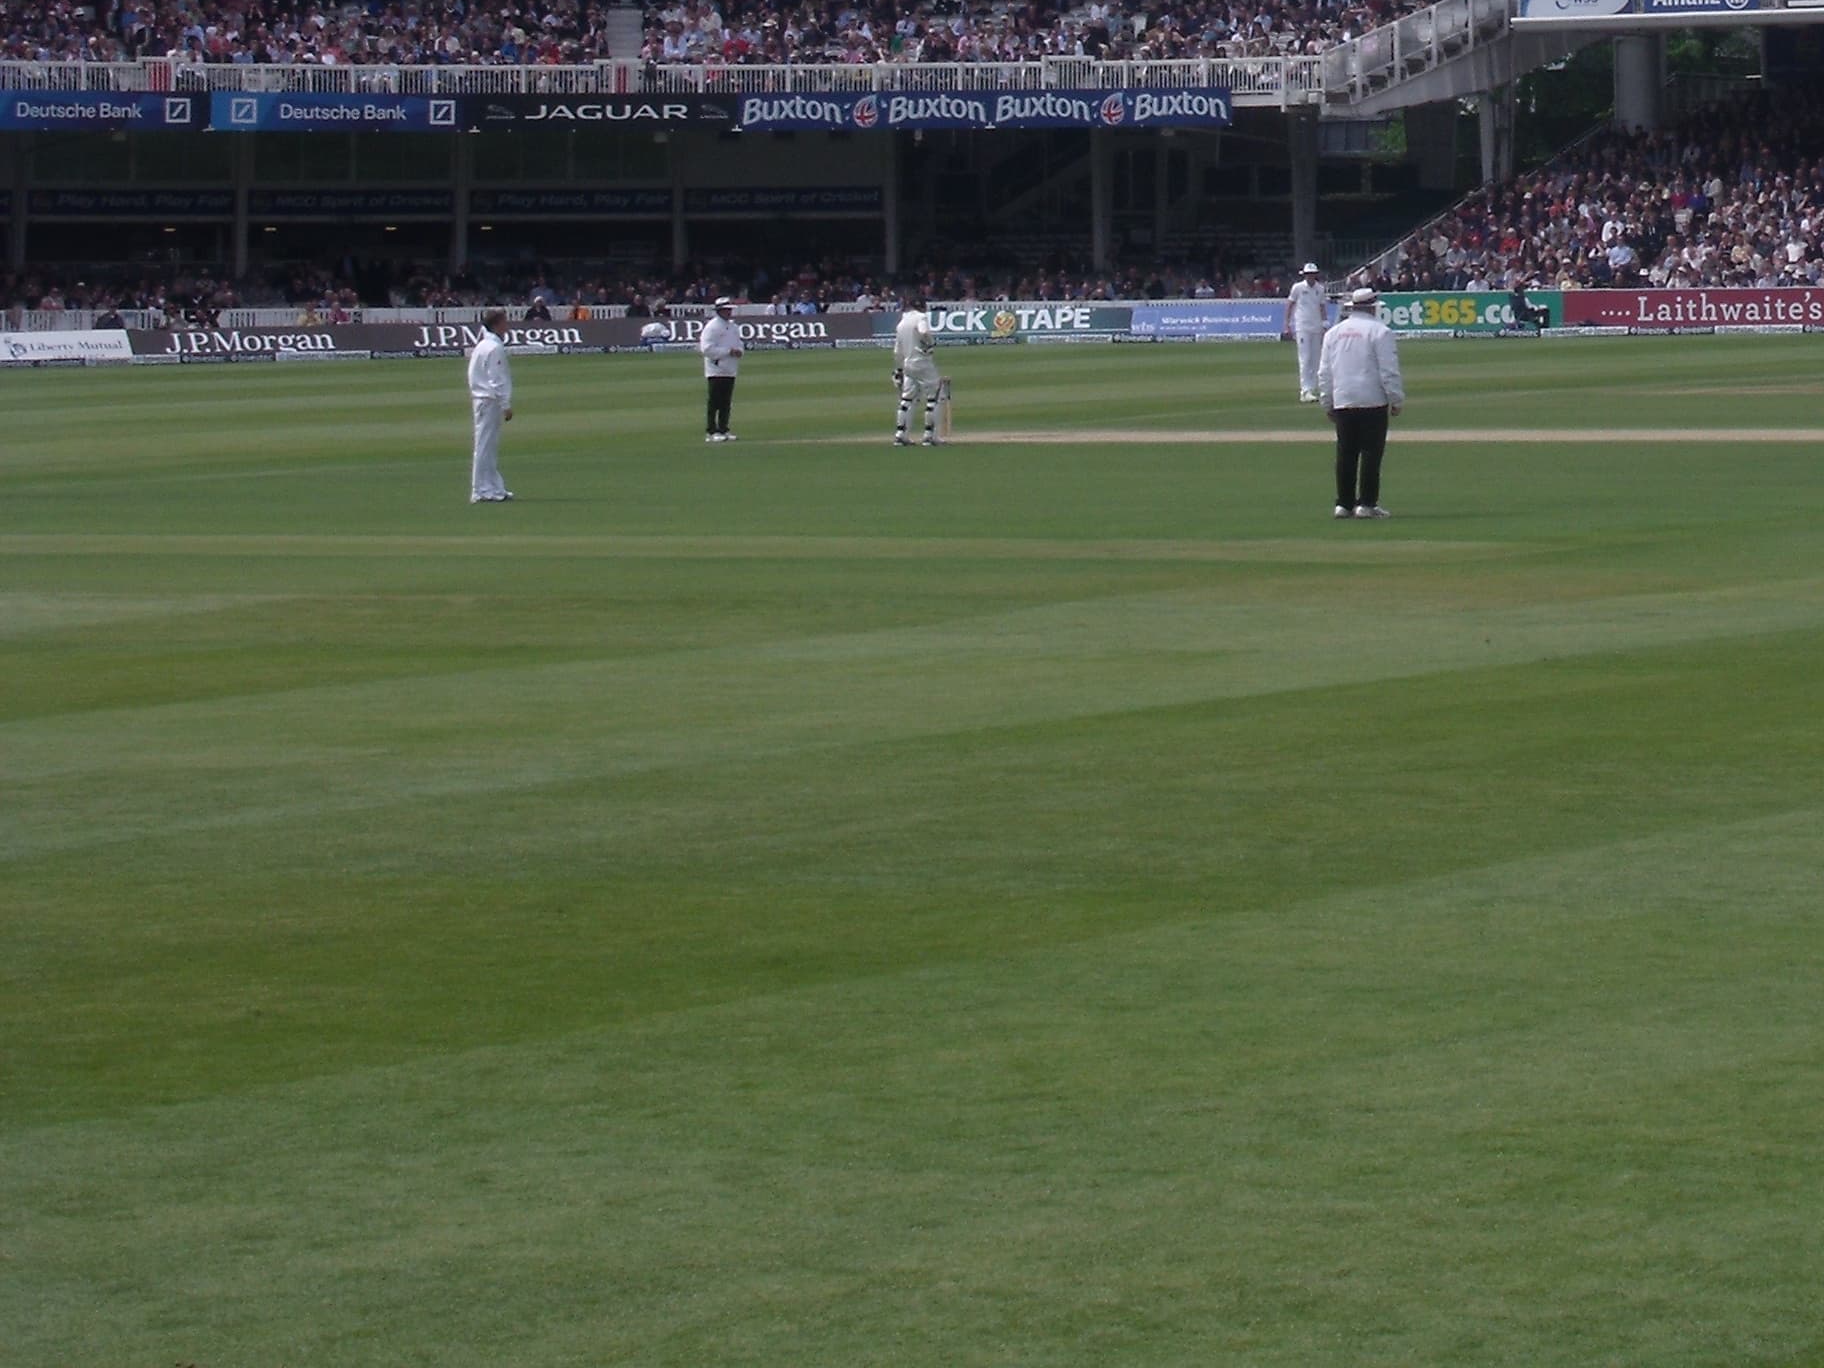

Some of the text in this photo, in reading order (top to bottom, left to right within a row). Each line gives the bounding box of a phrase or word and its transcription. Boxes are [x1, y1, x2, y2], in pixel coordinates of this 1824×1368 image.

[17, 102, 142, 119] Deutsche Bank
[280, 104, 407, 120] Deutsche Bank
[524, 104, 689, 120] JAGUAR
[742, 94, 843, 125] Buxton
[889, 93, 986, 123] Buxton
[996, 92, 1093, 123] Buxton
[1135, 91, 1228, 121] Buxton
[1637, 291, 1822, 322] Laithwaite's
[927, 307, 1091, 331] UCK TAPE
[165, 330, 336, 354] J.P.Morgan
[414, 325, 583, 348] J.P.Mrgan
